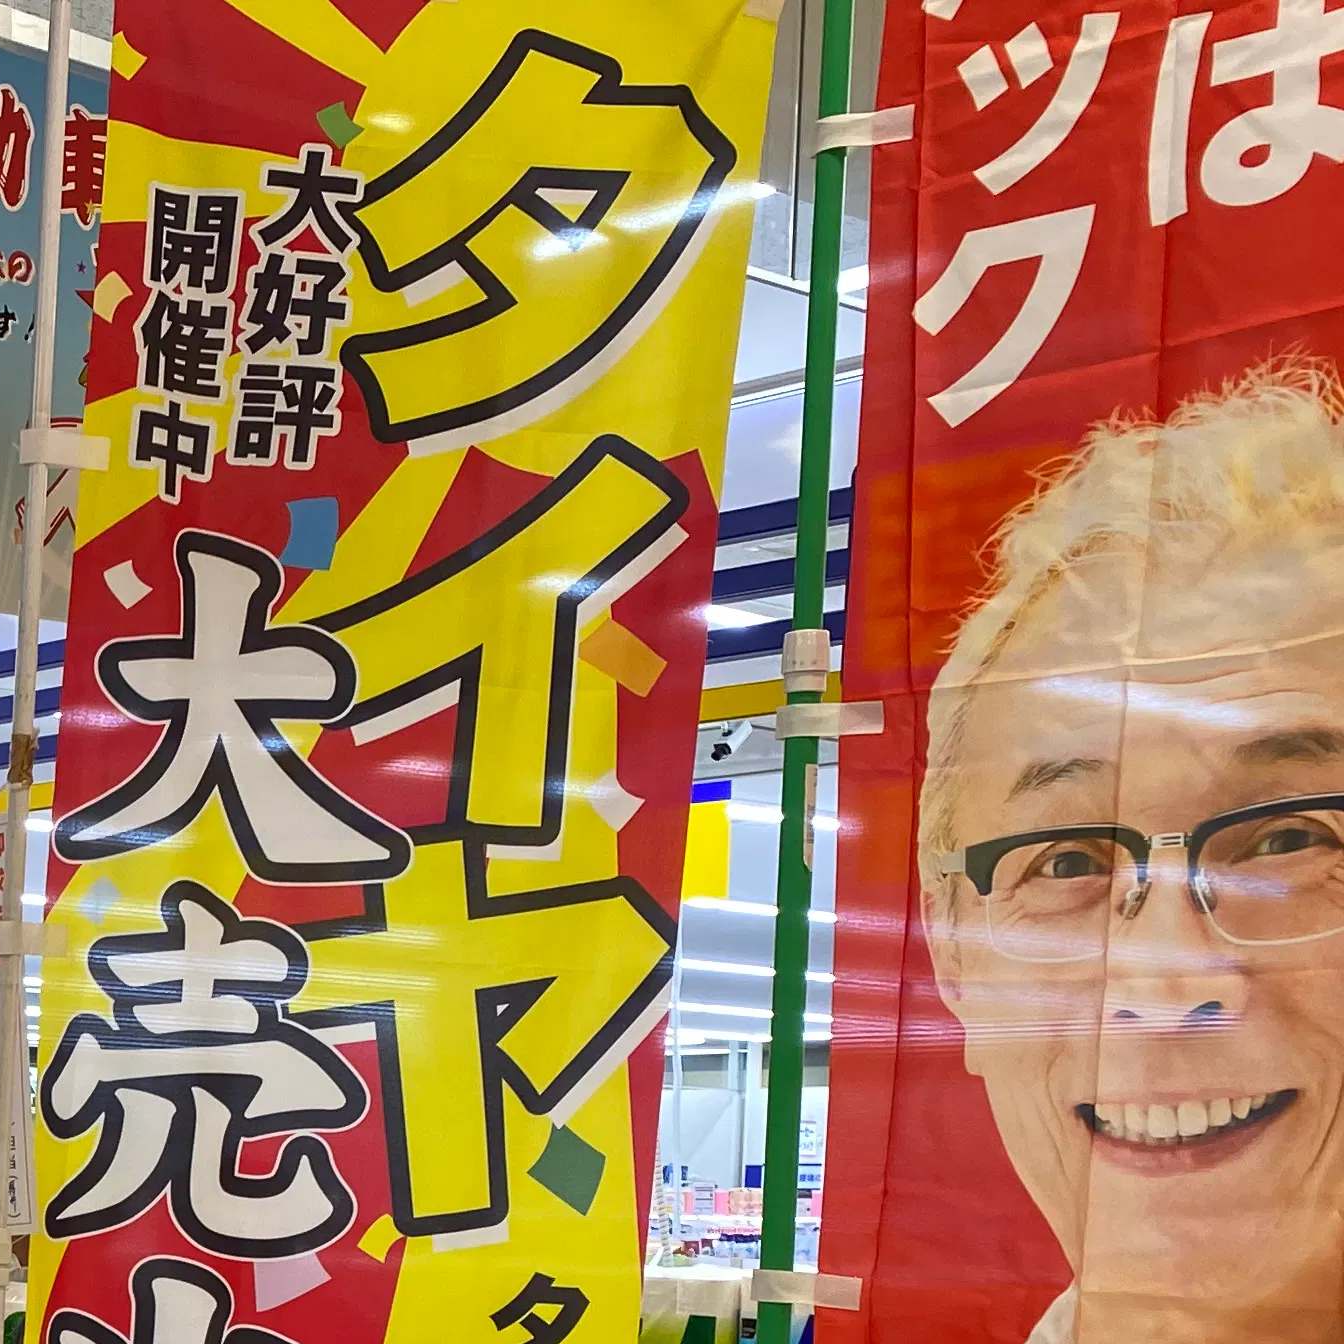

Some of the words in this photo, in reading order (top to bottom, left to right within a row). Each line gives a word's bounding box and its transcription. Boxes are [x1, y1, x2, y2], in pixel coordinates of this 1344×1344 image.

[132, 187, 240, 503] 開催中
[230, 145, 366, 470] 大好評
[912, 8, 1122, 430] ック
[280, 25, 739, 1240] タイヤ
